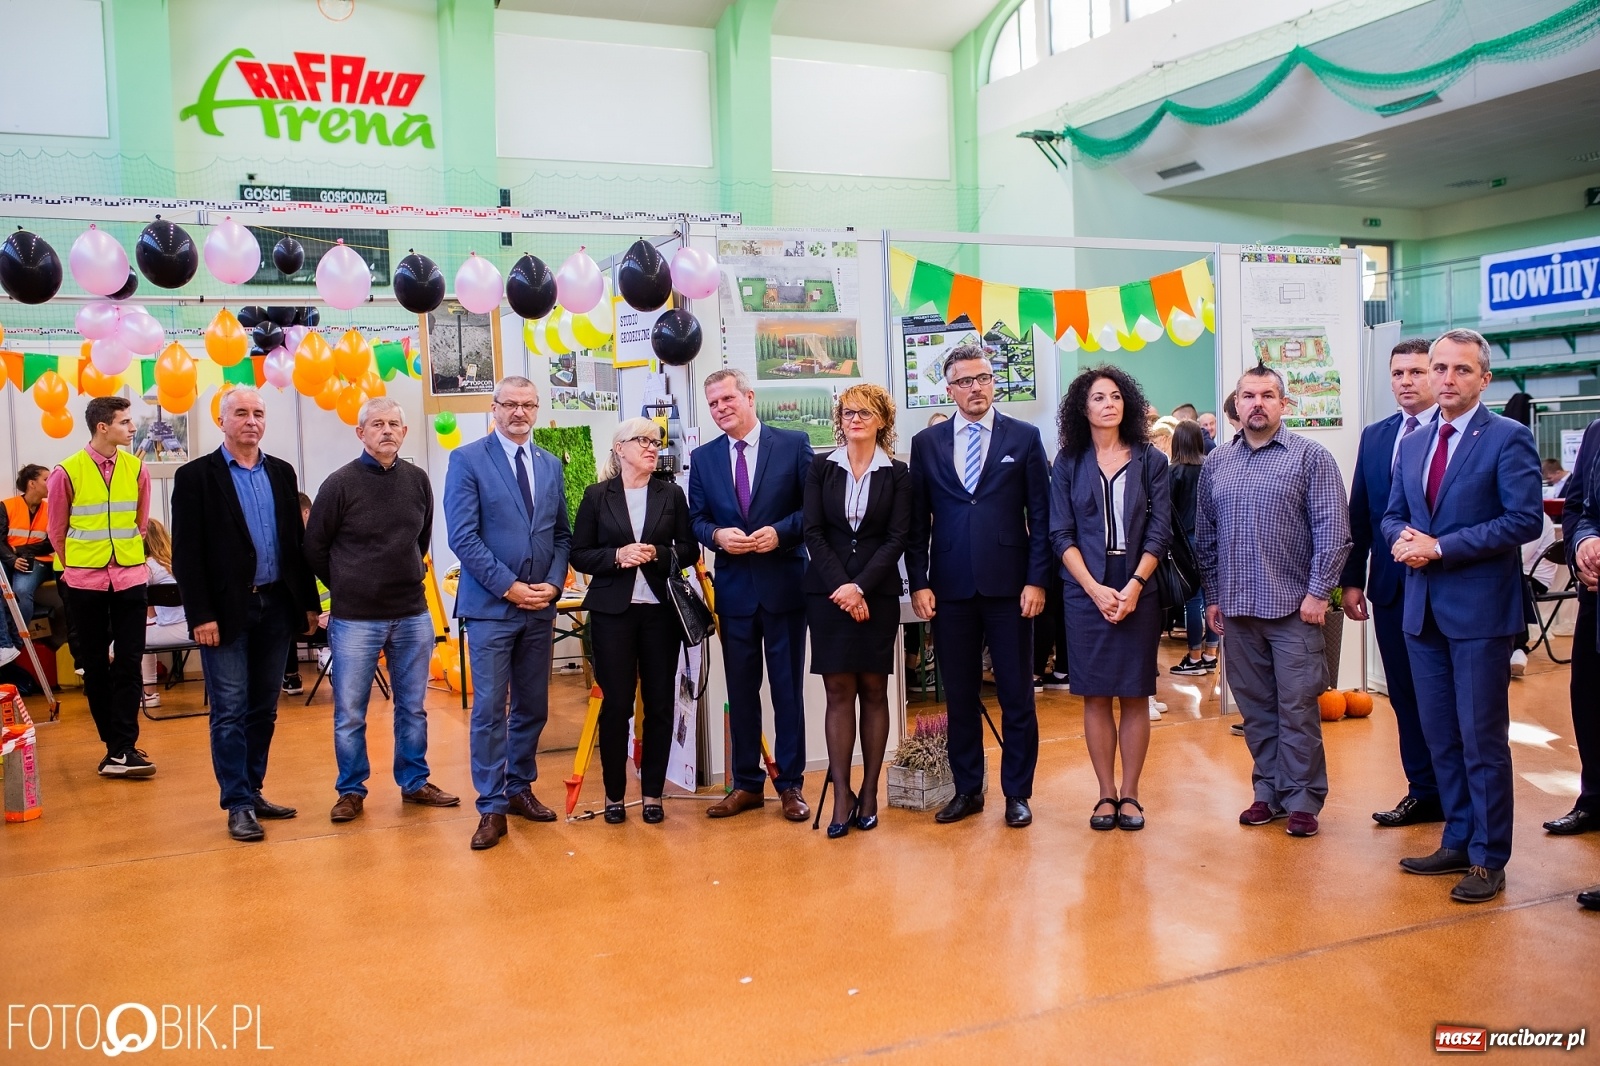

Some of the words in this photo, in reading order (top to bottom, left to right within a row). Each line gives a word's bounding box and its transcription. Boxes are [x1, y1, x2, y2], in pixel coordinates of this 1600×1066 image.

[235, 52, 426, 107] RAFAKO
[179, 48, 436, 149] Arena
[243, 187, 291, 201] GOŚCIE
[320, 190, 386, 203] GOSPODARZE
[1491, 253, 1600, 303] nowiny
[620, 313, 638, 327] STUDIO
[621, 328, 650, 343] GEODEZYJNE
